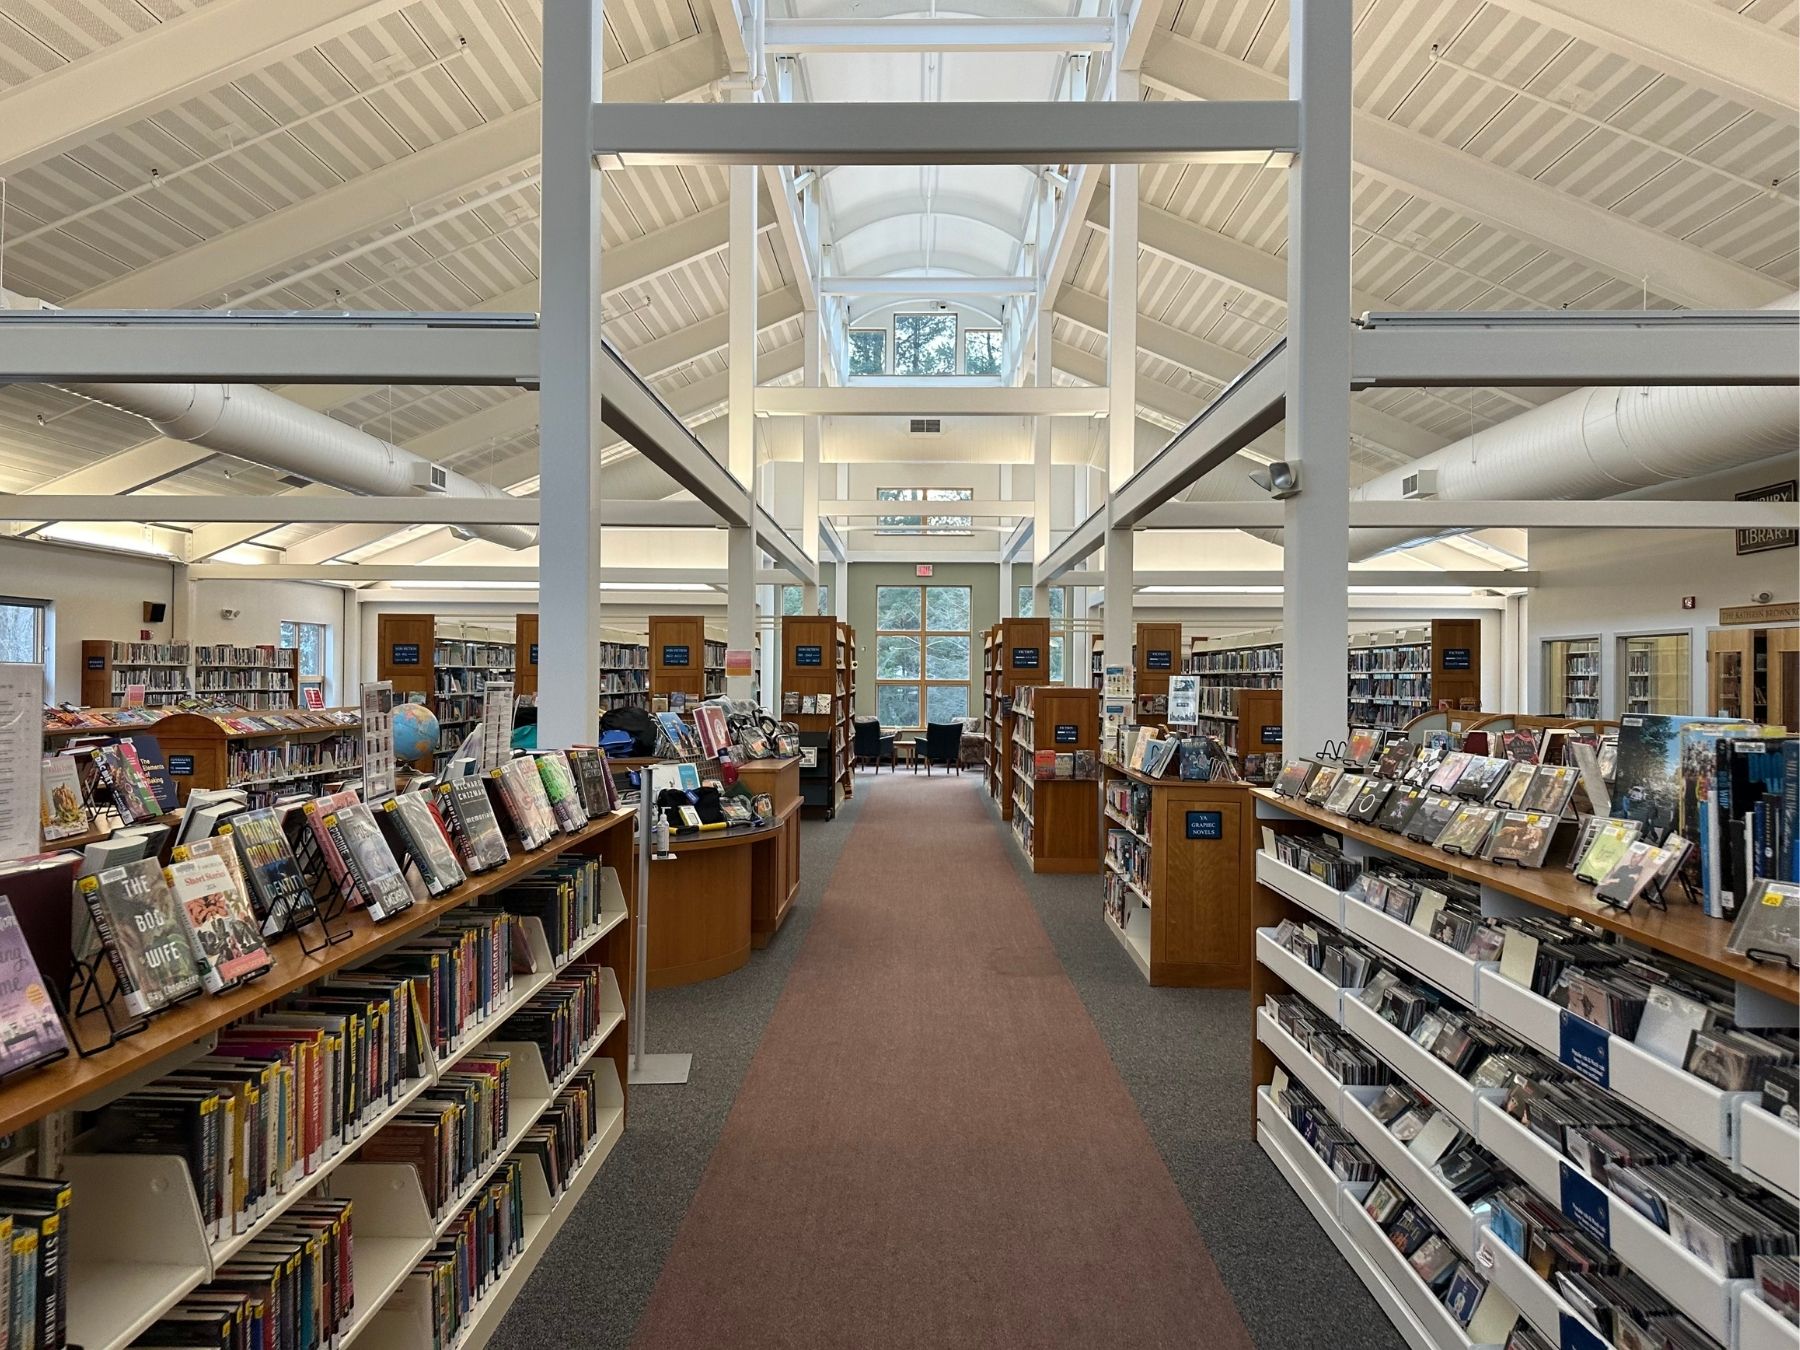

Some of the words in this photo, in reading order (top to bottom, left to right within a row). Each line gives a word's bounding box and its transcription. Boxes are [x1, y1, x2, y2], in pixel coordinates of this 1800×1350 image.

[1740, 527, 1790, 546] LIBRARY
[444, 794, 461, 831] emorials
[121, 875, 151, 898] THE
[184, 875, 204, 887] Short
[134, 908, 165, 933] BOG
[145, 942, 181, 968] WIFE
[44, 1236, 59, 1279] STAG
